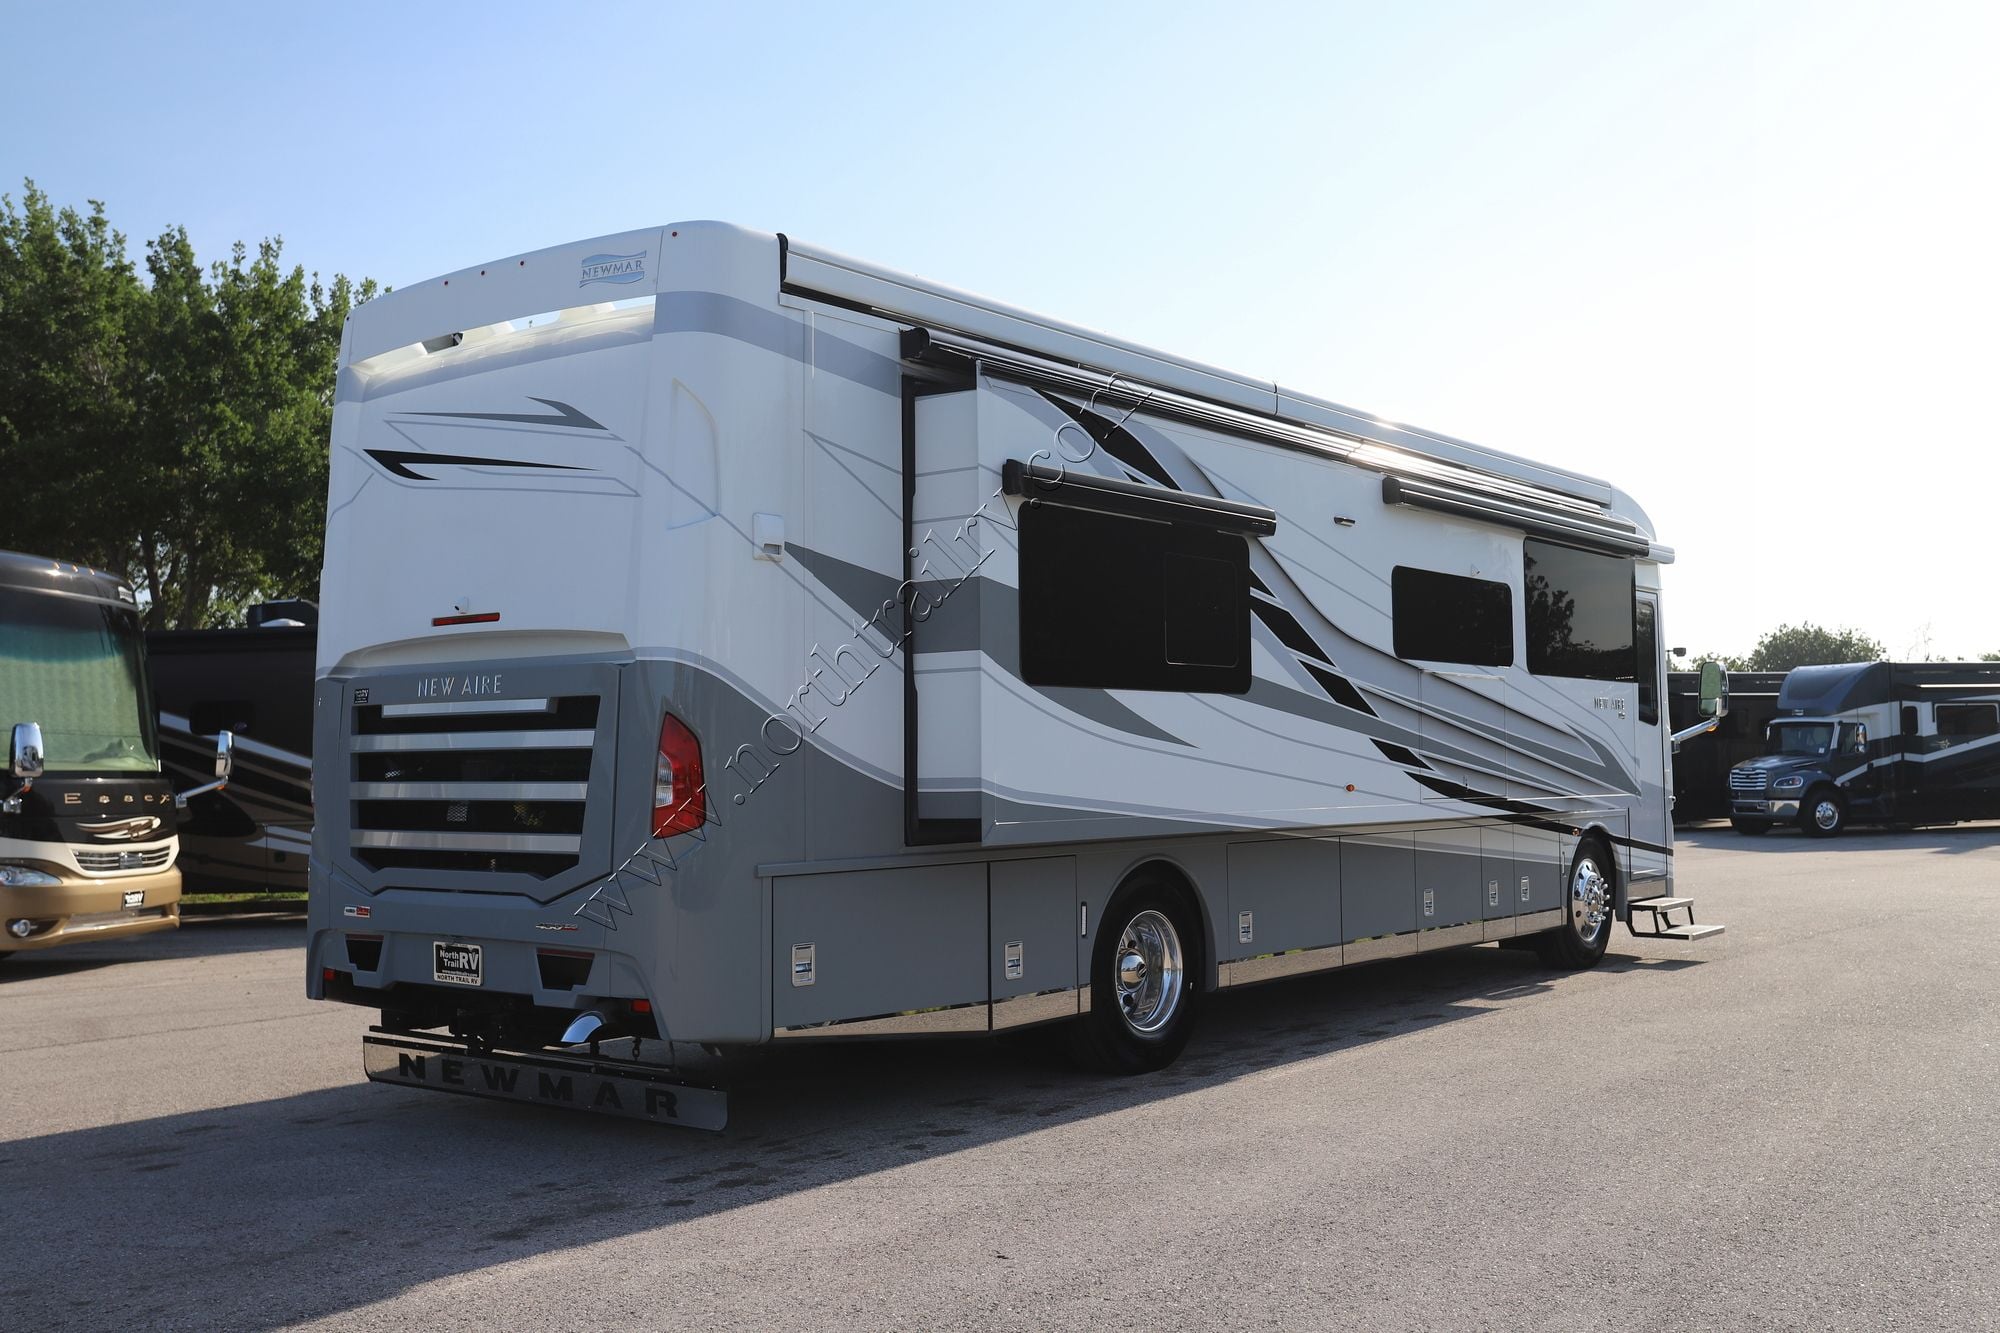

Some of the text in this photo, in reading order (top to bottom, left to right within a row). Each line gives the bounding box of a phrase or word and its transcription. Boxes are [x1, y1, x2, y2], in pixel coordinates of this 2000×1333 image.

[582, 260, 644, 279] NEWMAR
[418, 674, 502, 697] NEW AIRE
[440, 950, 459, 959] North
[444, 959, 459, 968] Trail
[459, 952, 479, 970] RV
[400, 1052, 680, 1119] NEWMAR
